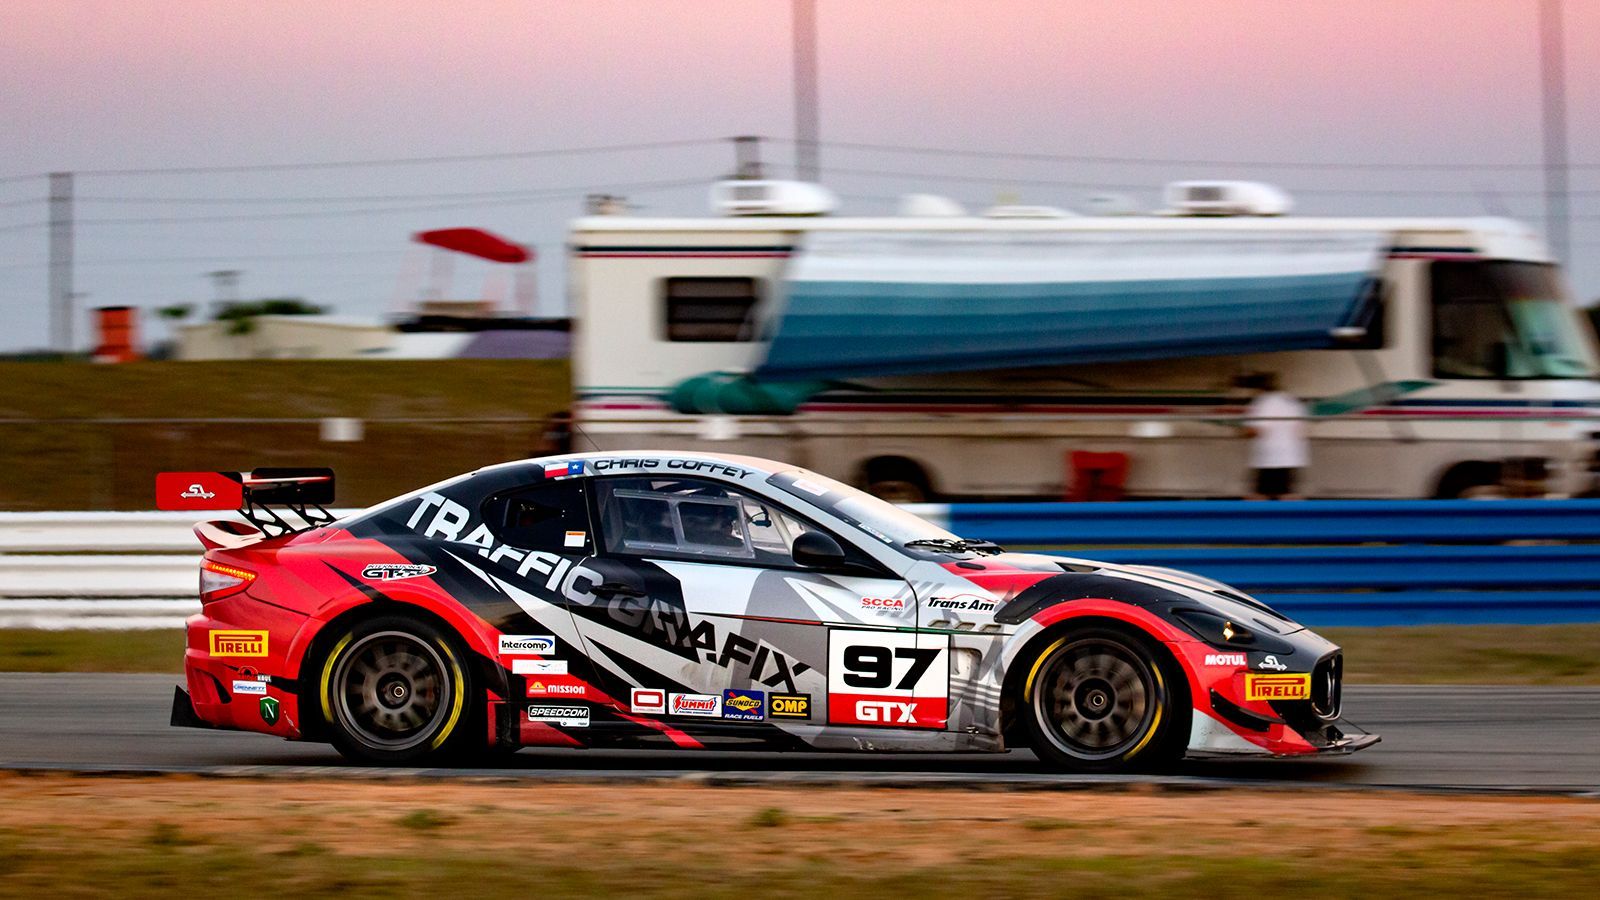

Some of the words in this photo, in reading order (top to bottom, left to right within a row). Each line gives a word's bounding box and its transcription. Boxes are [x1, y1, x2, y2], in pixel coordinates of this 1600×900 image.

[593, 458, 660, 471] CHRIS
[667, 459, 754, 479] COFFEY
[405, 491, 605, 607] TRAFFIC
[862, 597, 904, 608] SCCA
[927, 596, 968, 610] Trans
[968, 599, 995, 611] Am
[214, 634, 263, 654] PIRELLI
[501, 640, 548, 651] Intercomp
[843, 644, 943, 691] 97
[1204, 654, 1247, 666] MOTUL
[1250, 677, 1306, 697] PIRELLI
[726, 698, 761, 708] SUNOCO
[772, 699, 808, 713] OMP
[530, 708, 588, 717] SPEEDCOM
[855, 700, 918, 724] GTX
